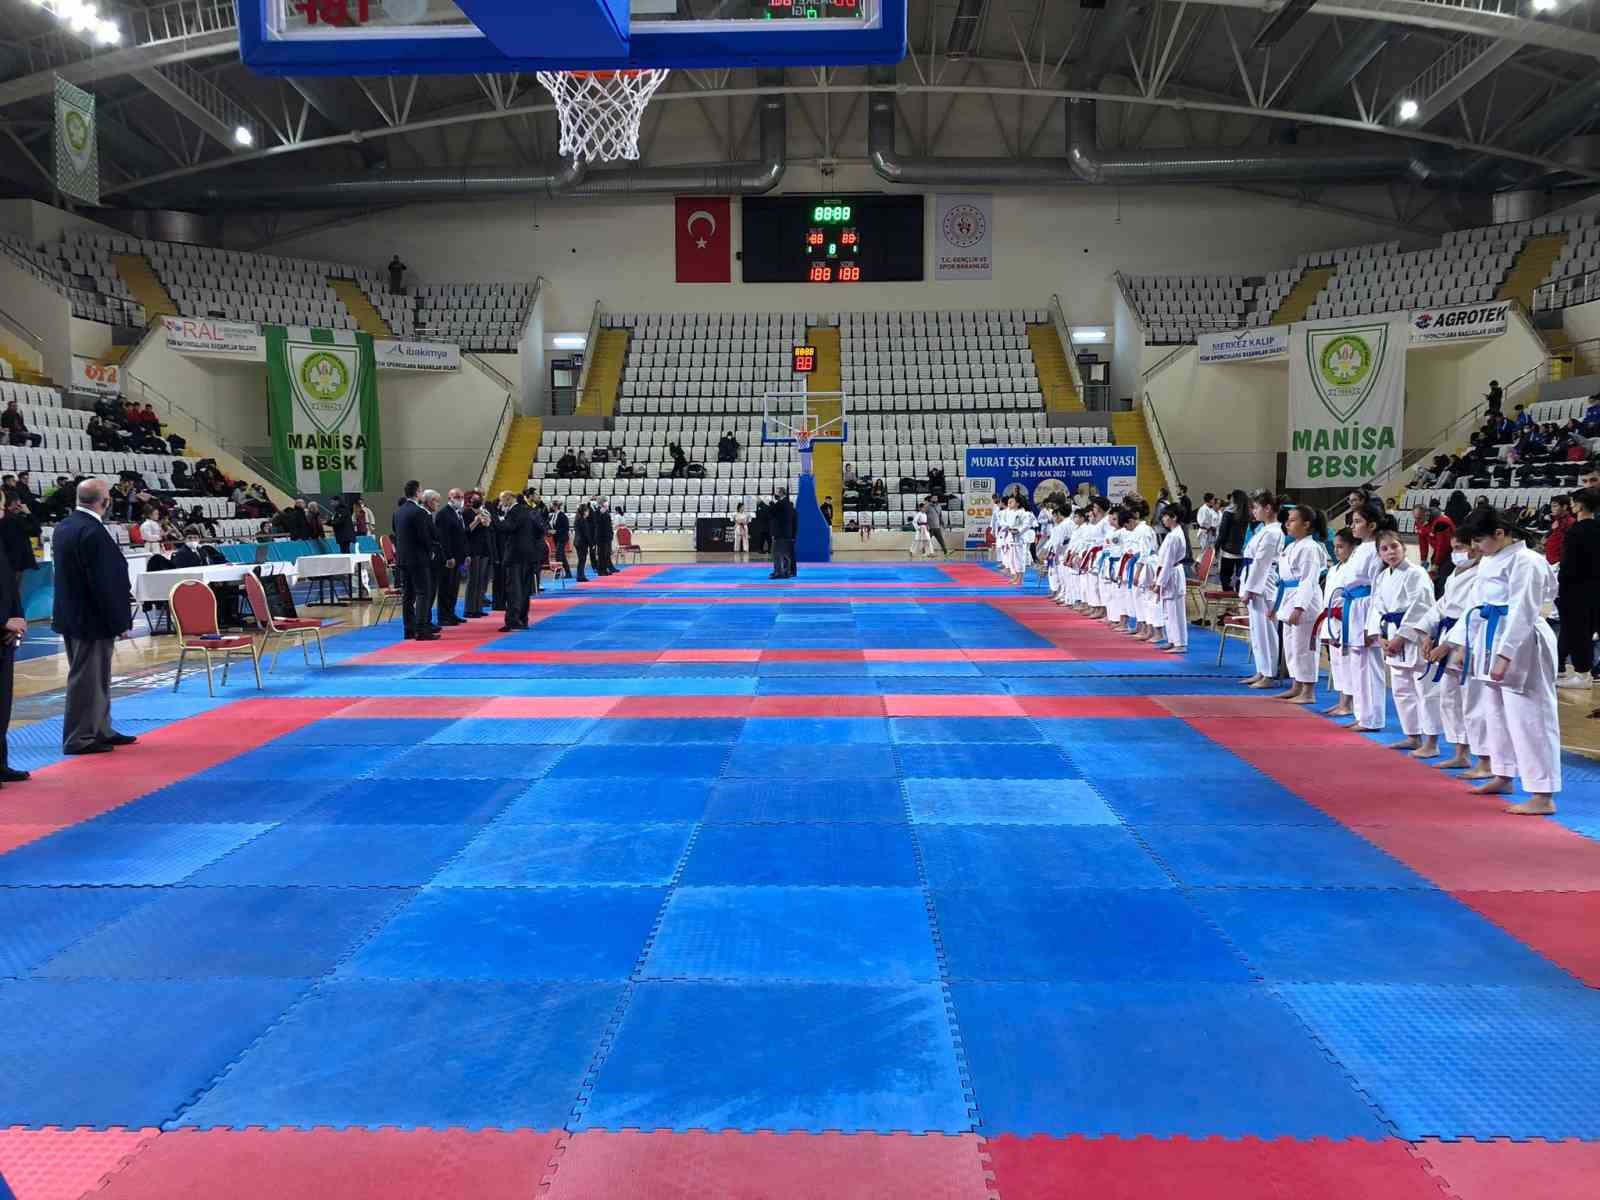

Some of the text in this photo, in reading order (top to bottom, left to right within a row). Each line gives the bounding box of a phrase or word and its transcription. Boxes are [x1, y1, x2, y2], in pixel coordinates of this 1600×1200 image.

[1433, 306, 1508, 328] AGROTEK
[183, 321, 224, 341] RAL
[1212, 340, 1247, 351] MERKEZ
[1292, 421, 1396, 452] MANİSA
[301, 455, 358, 471] BBSK
[970, 454, 1136, 469] MURAT EŞSİZ KARATE TURNUVASI
[1306, 454, 1377, 479] BBSK
